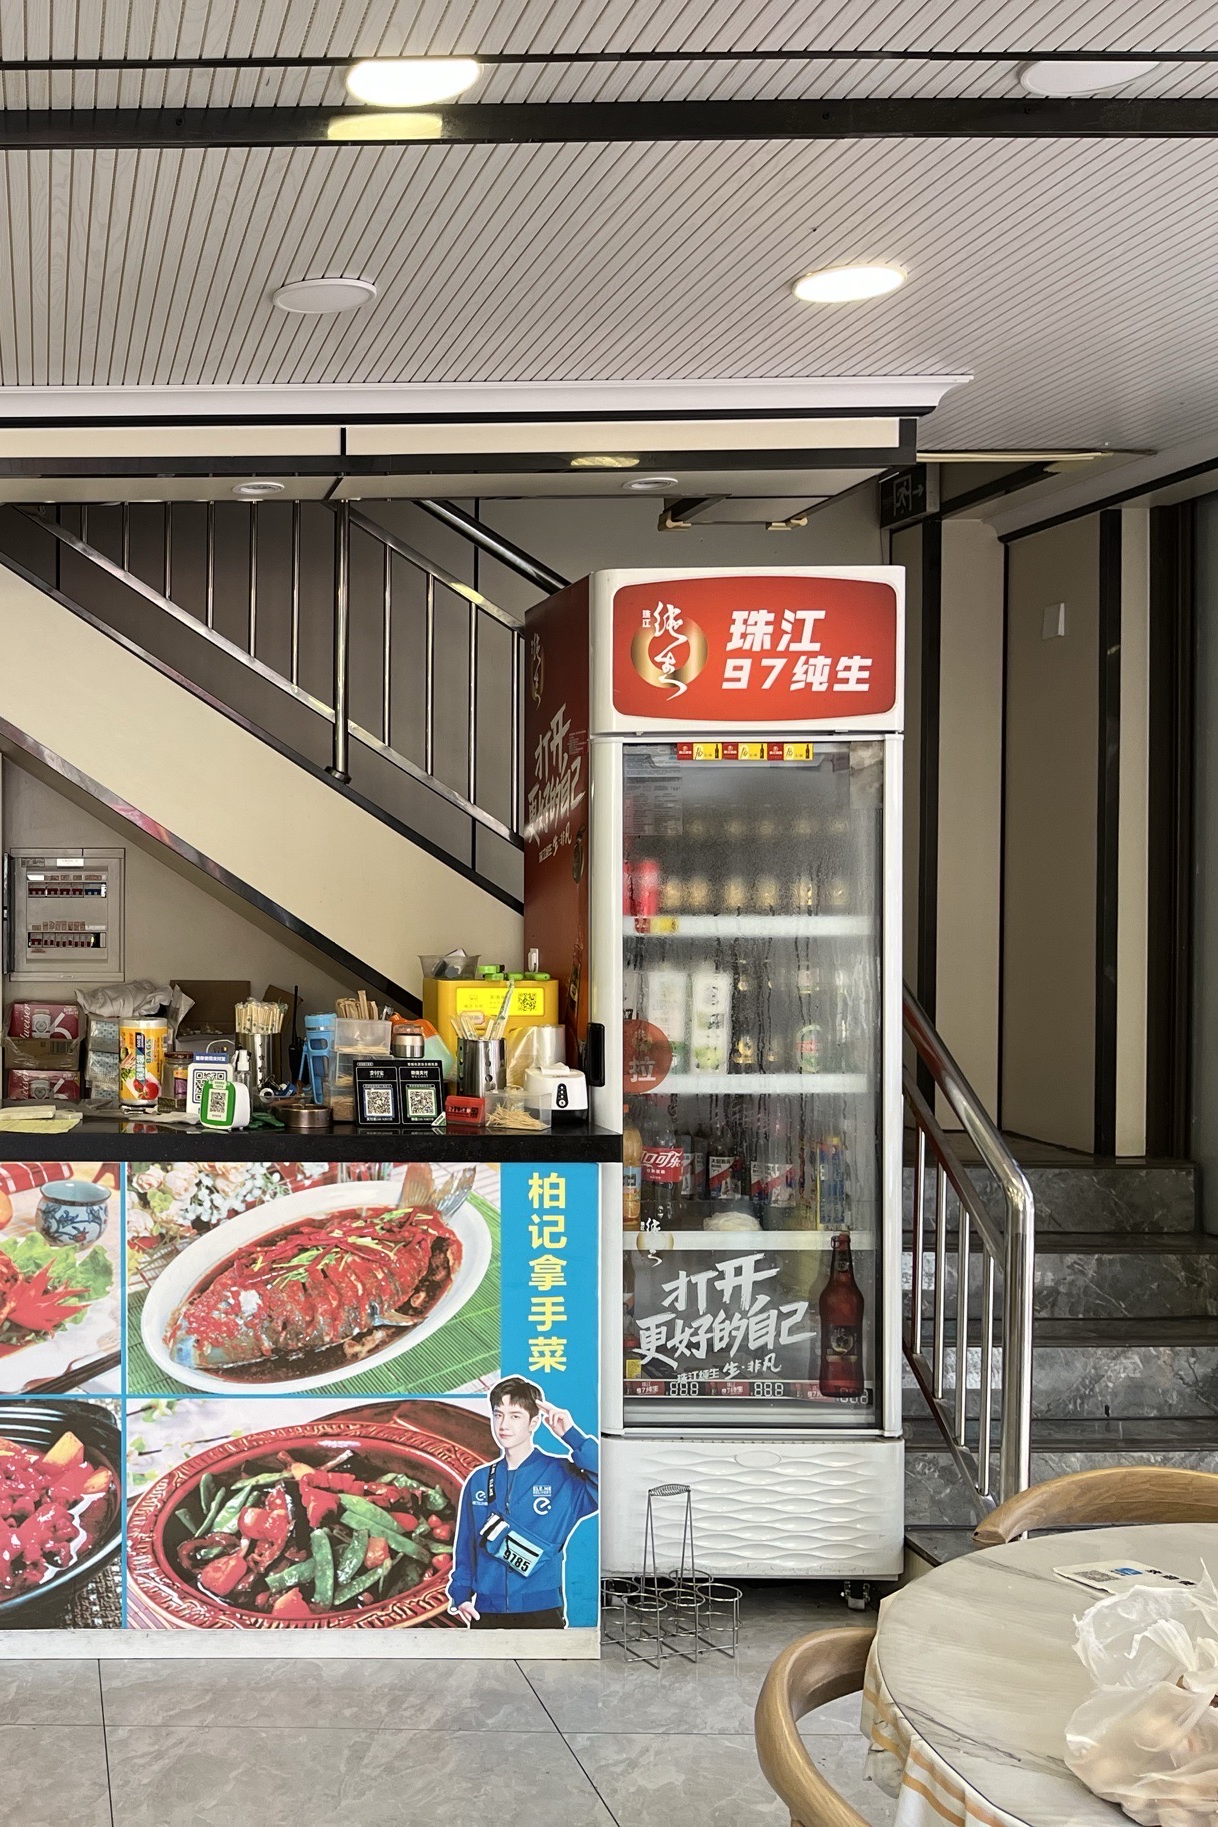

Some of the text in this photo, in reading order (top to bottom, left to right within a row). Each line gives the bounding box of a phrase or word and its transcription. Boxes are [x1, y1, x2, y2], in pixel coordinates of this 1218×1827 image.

[642, 609, 651, 628] 珠江
[725, 609, 826, 651] 珠江
[721, 655, 873, 692] 97纯生
[145, 1038, 153, 1063] BAGS
[629, 1055, 657, 1083] 拉
[641, 1150, 683, 1168] 口可乐
[528, 1172, 568, 1373] 柏记拿手菜
[661, 1253, 780, 1315] 打开
[632, 1295, 817, 1370] 更好的自己
[503, 1550, 531, 1572] 9785
